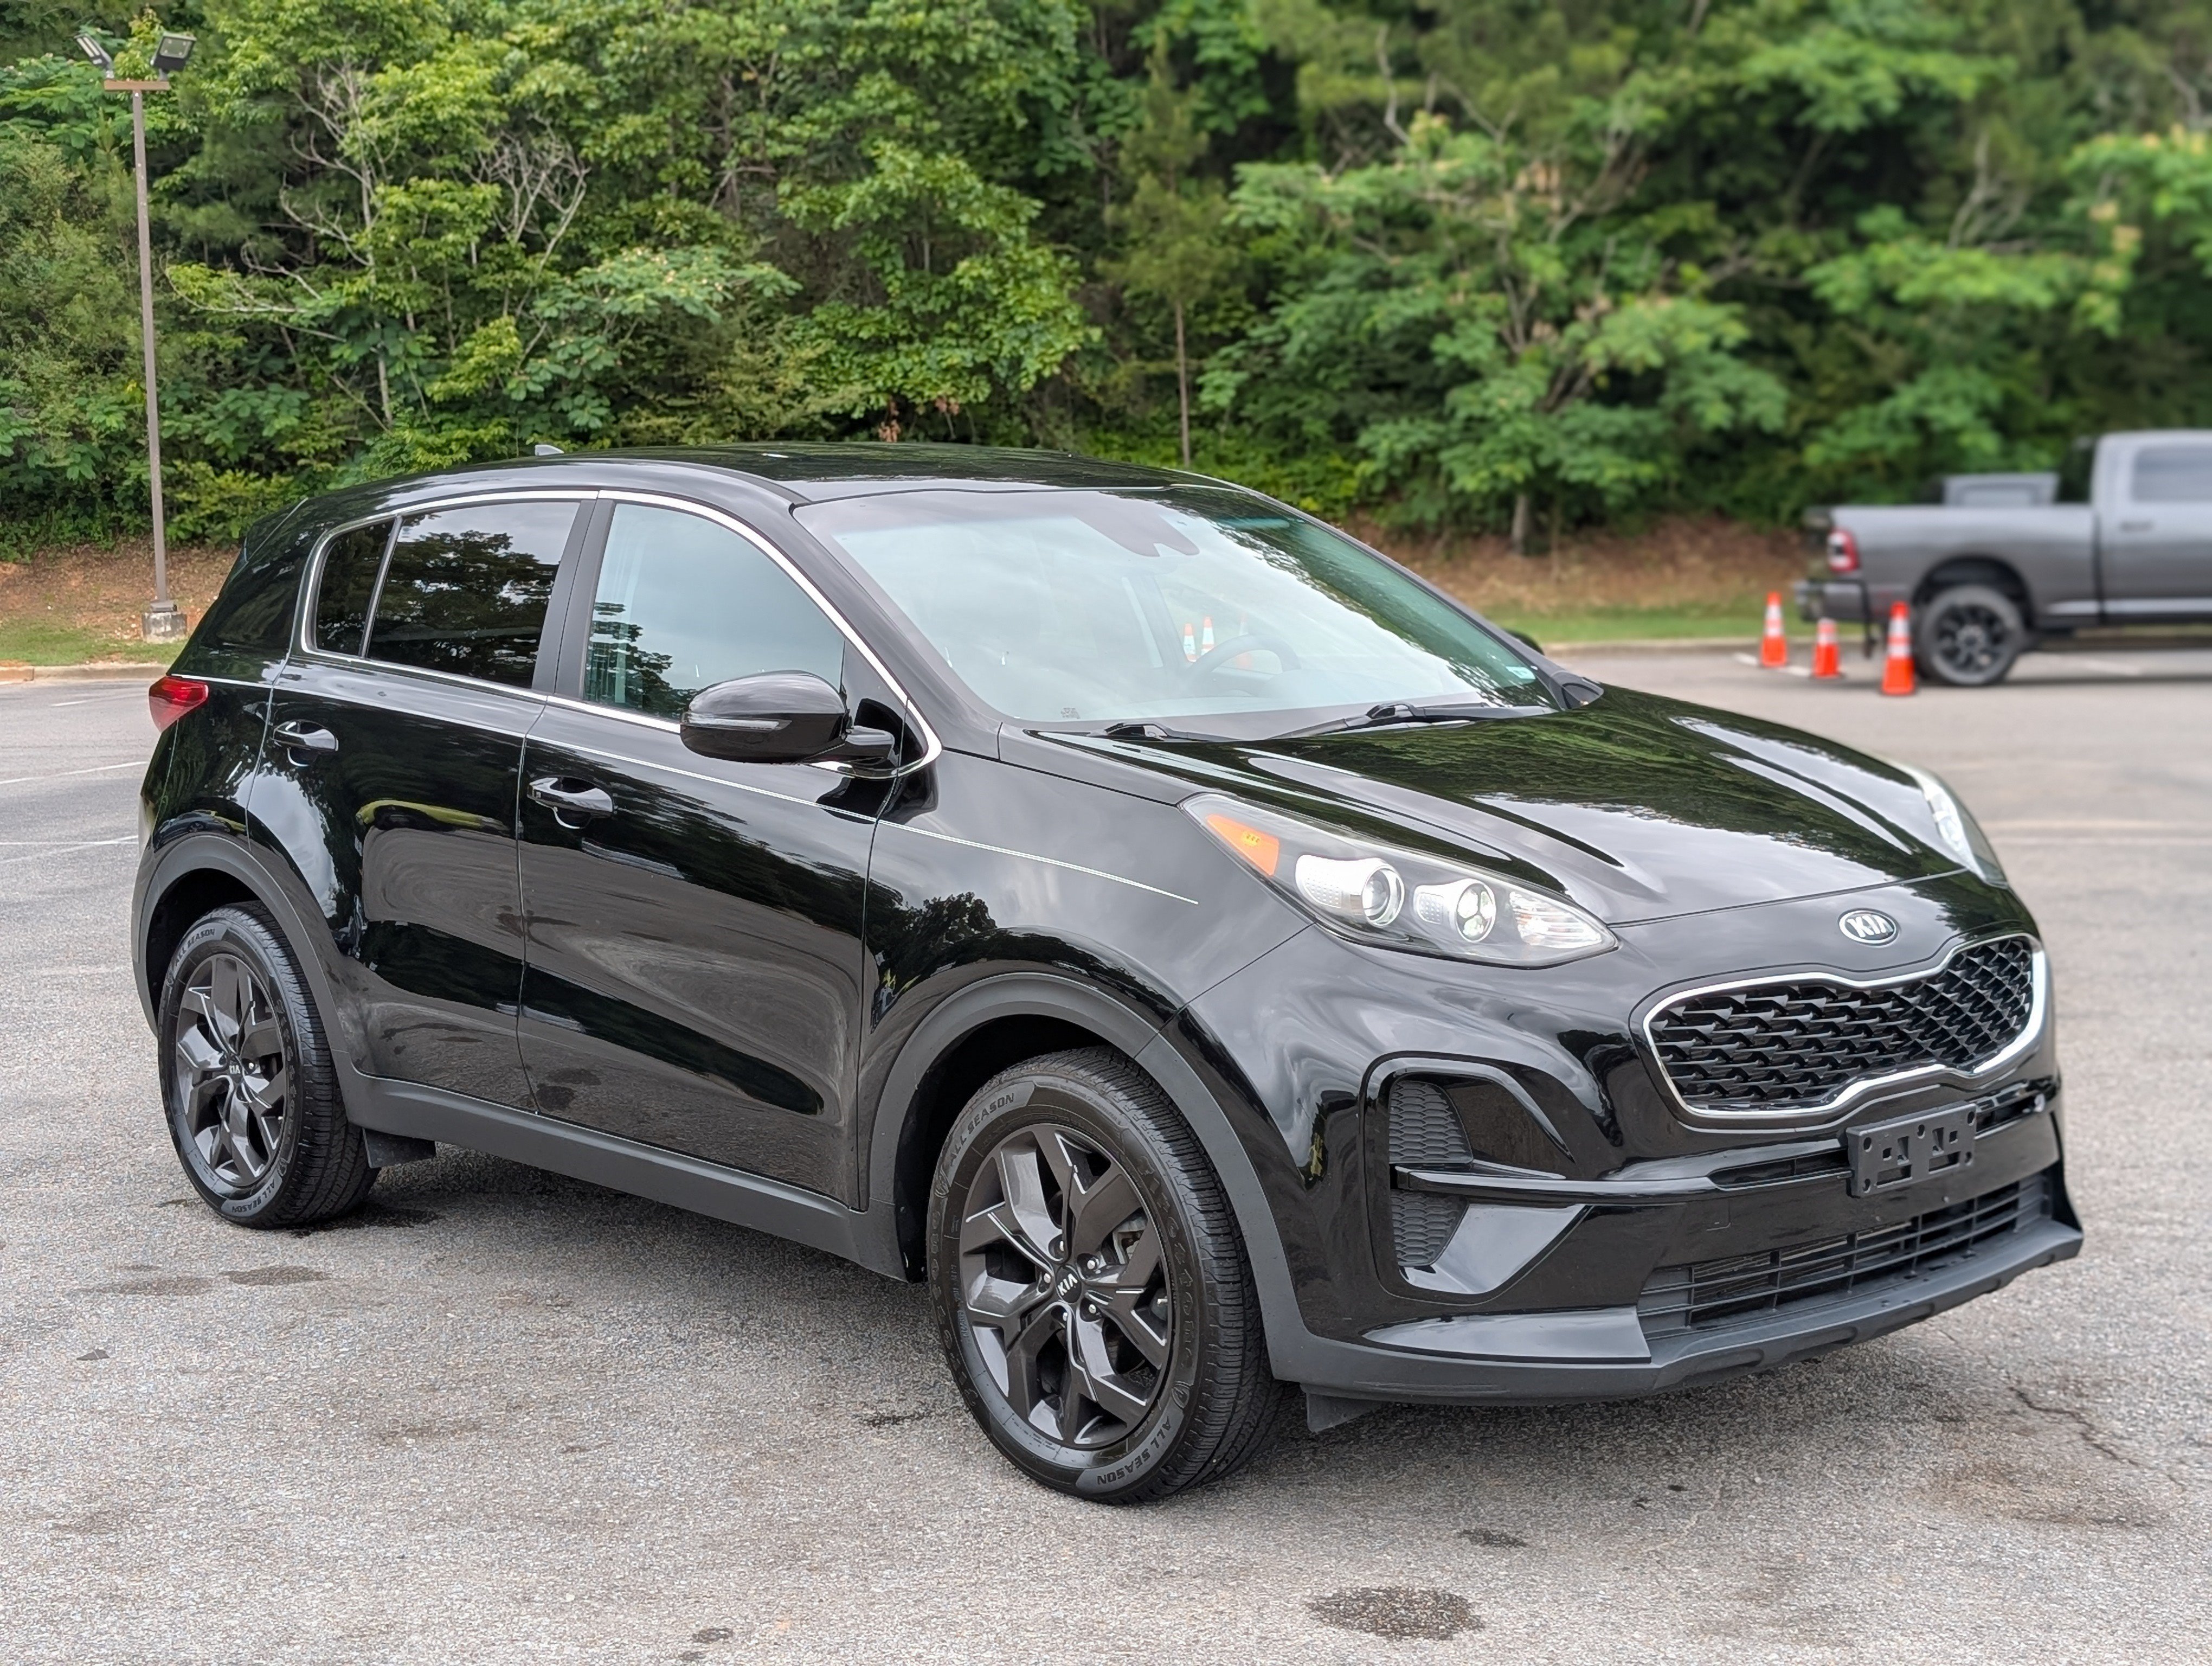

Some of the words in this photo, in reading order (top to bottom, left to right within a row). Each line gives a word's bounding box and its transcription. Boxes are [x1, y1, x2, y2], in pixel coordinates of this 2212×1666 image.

[1847, 914, 1894, 938] KIA
[950, 1136, 967, 1167] ALL
[967, 1092, 1014, 1135] SEASON
[1057, 1273, 1078, 1296] KIA
[1150, 1415, 1171, 1449] ALL
[1096, 1448, 1151, 1485] SEASON
